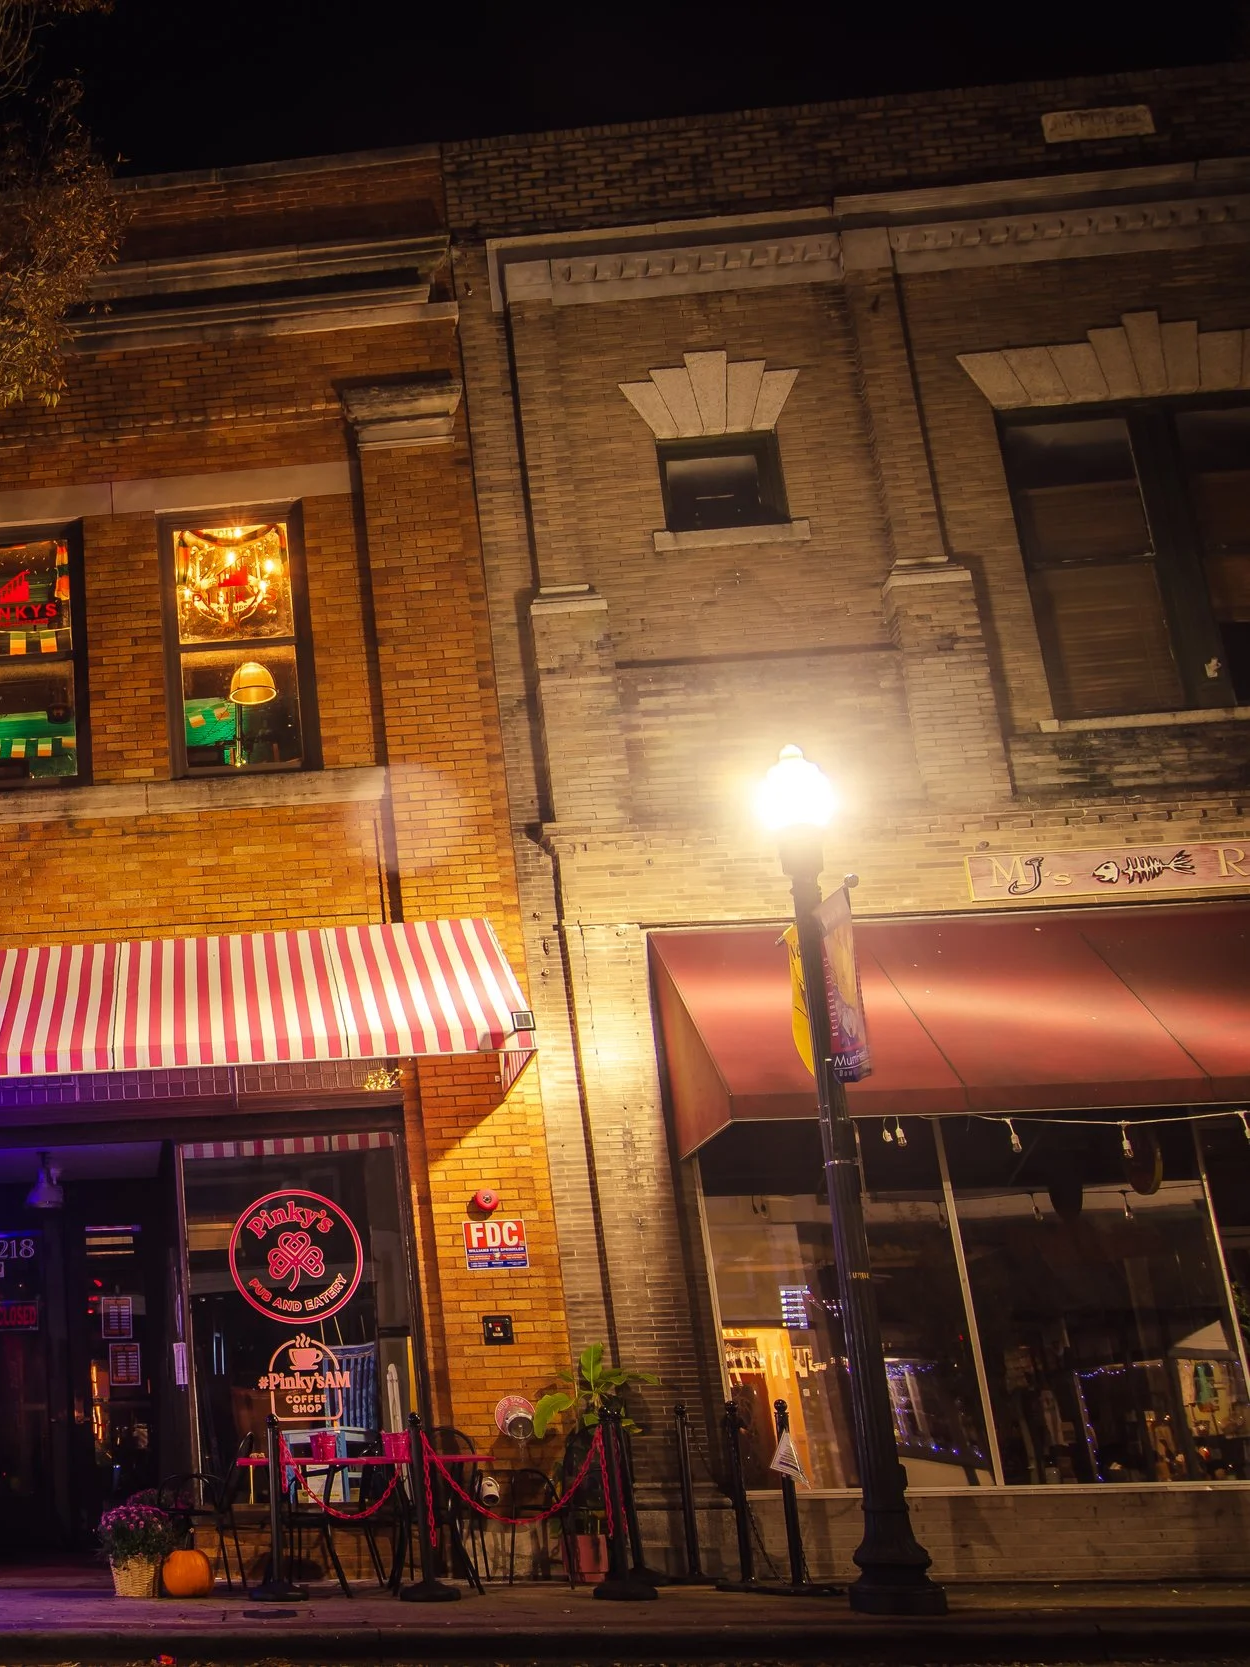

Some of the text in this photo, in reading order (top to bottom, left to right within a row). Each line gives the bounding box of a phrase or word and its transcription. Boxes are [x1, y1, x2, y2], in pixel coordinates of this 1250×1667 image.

[246, 1200, 335, 1240] Pinky's
[470, 1221, 519, 1248] FDC
[248, 1272, 347, 1312] PUB AND EATERY
[258, 1370, 351, 1394] #Pinky'sAM
[285, 1394, 328, 1405] COFFEE
[291, 1404, 323, 1415] SHOP
